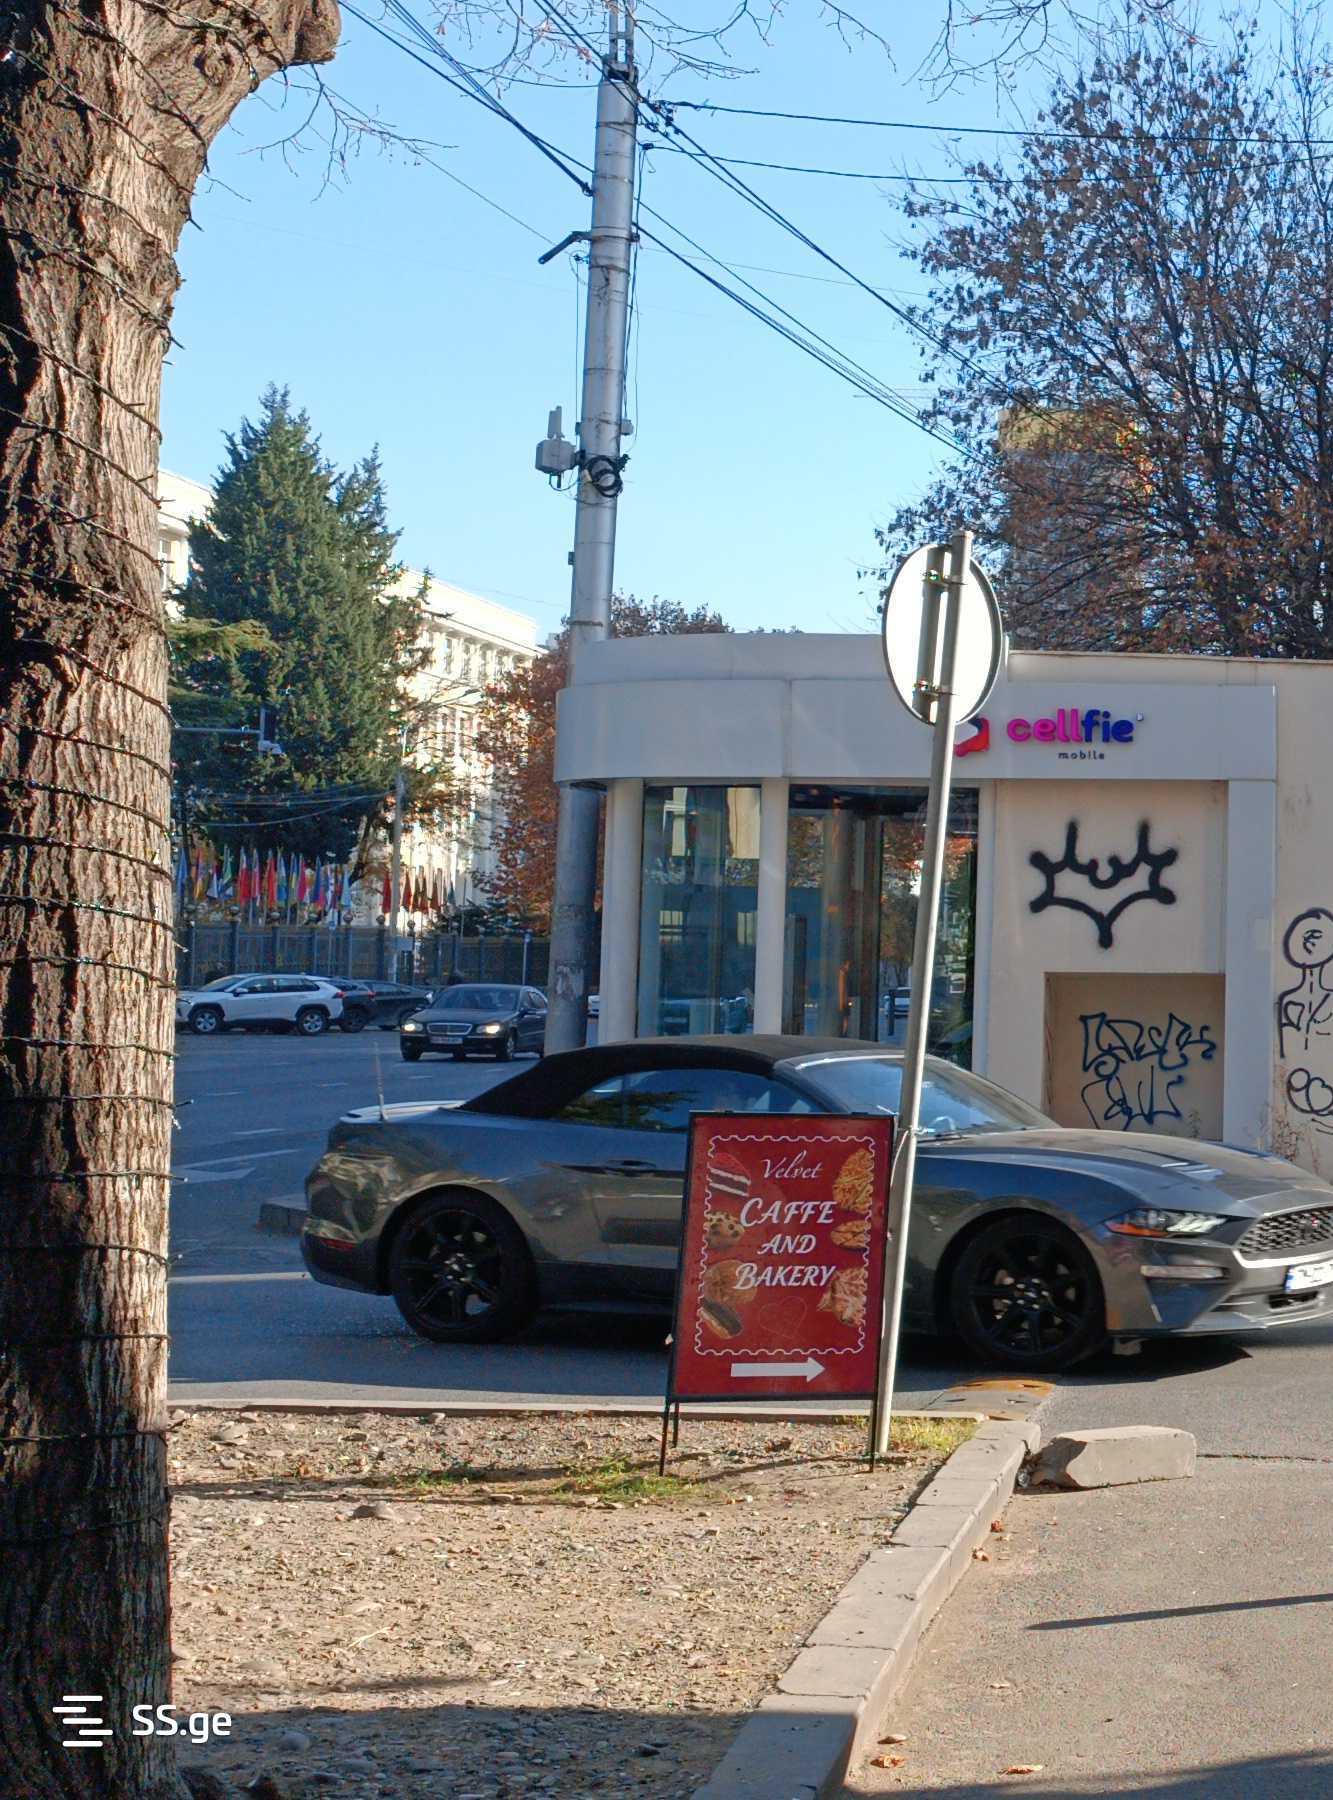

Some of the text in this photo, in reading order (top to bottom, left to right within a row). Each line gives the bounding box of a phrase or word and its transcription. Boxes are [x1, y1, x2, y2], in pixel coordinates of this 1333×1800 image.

[1007, 708, 1135, 743] cellfie
[1058, 750, 1105, 760] mobile
[762, 1149, 824, 1180] Velvet
[739, 1198, 837, 1228] CAFFE
[757, 1234, 817, 1255] AND
[734, 1262, 836, 1291] BAKERY
